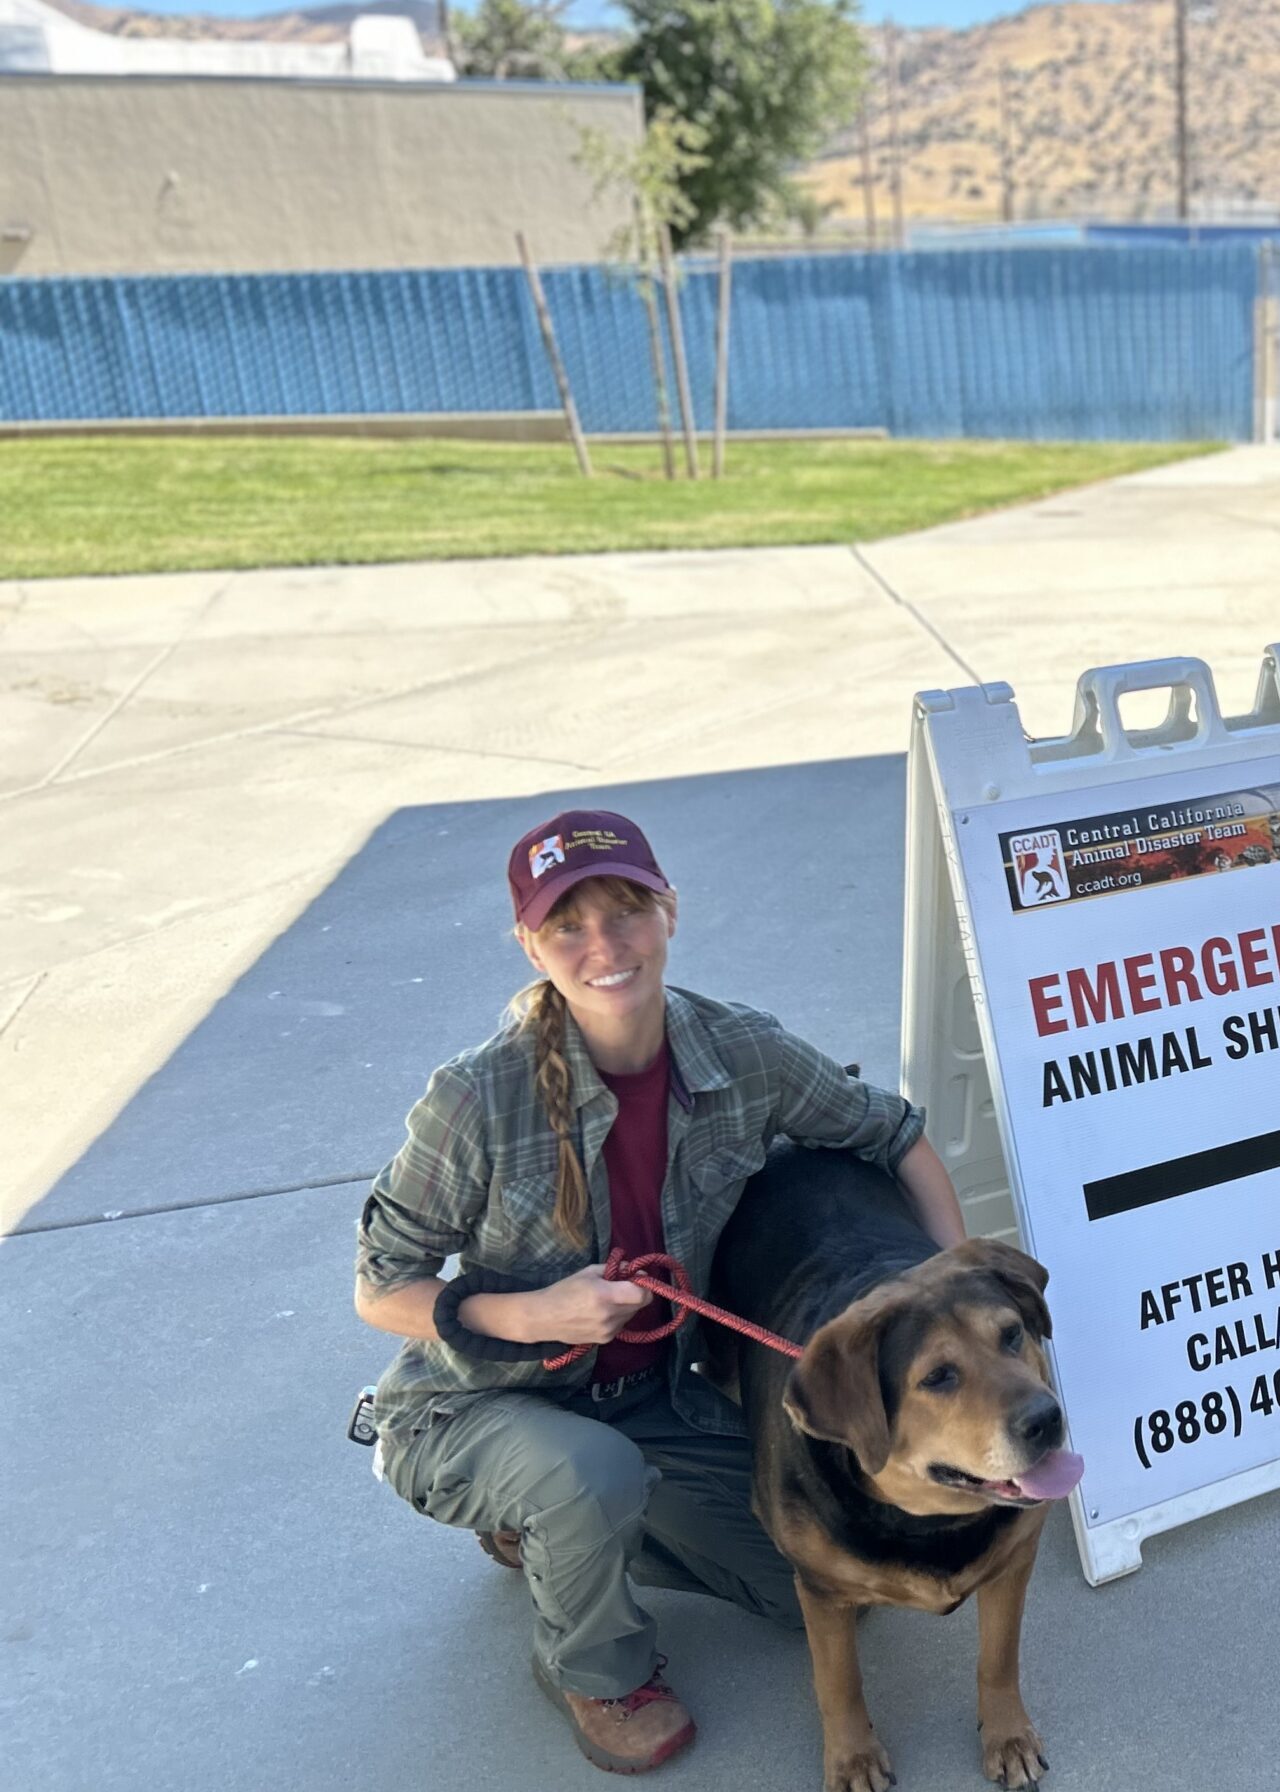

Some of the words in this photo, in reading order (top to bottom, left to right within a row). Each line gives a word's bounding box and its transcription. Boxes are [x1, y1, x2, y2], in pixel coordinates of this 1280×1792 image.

[1012, 833, 1058, 854] CCADT
[1067, 817, 1140, 846] Central
[1148, 802, 1245, 831] California
[1071, 841, 1131, 867] Animal
[1136, 831, 1202, 855] Disaster
[1204, 823, 1247, 841] Team
[1076, 872, 1142, 894] ccadt.org
[1042, 1026, 1213, 1108] ANIMAL
[1139, 1261, 1254, 1331] AFTER
[1134, 1385, 1243, 1469] (888)
